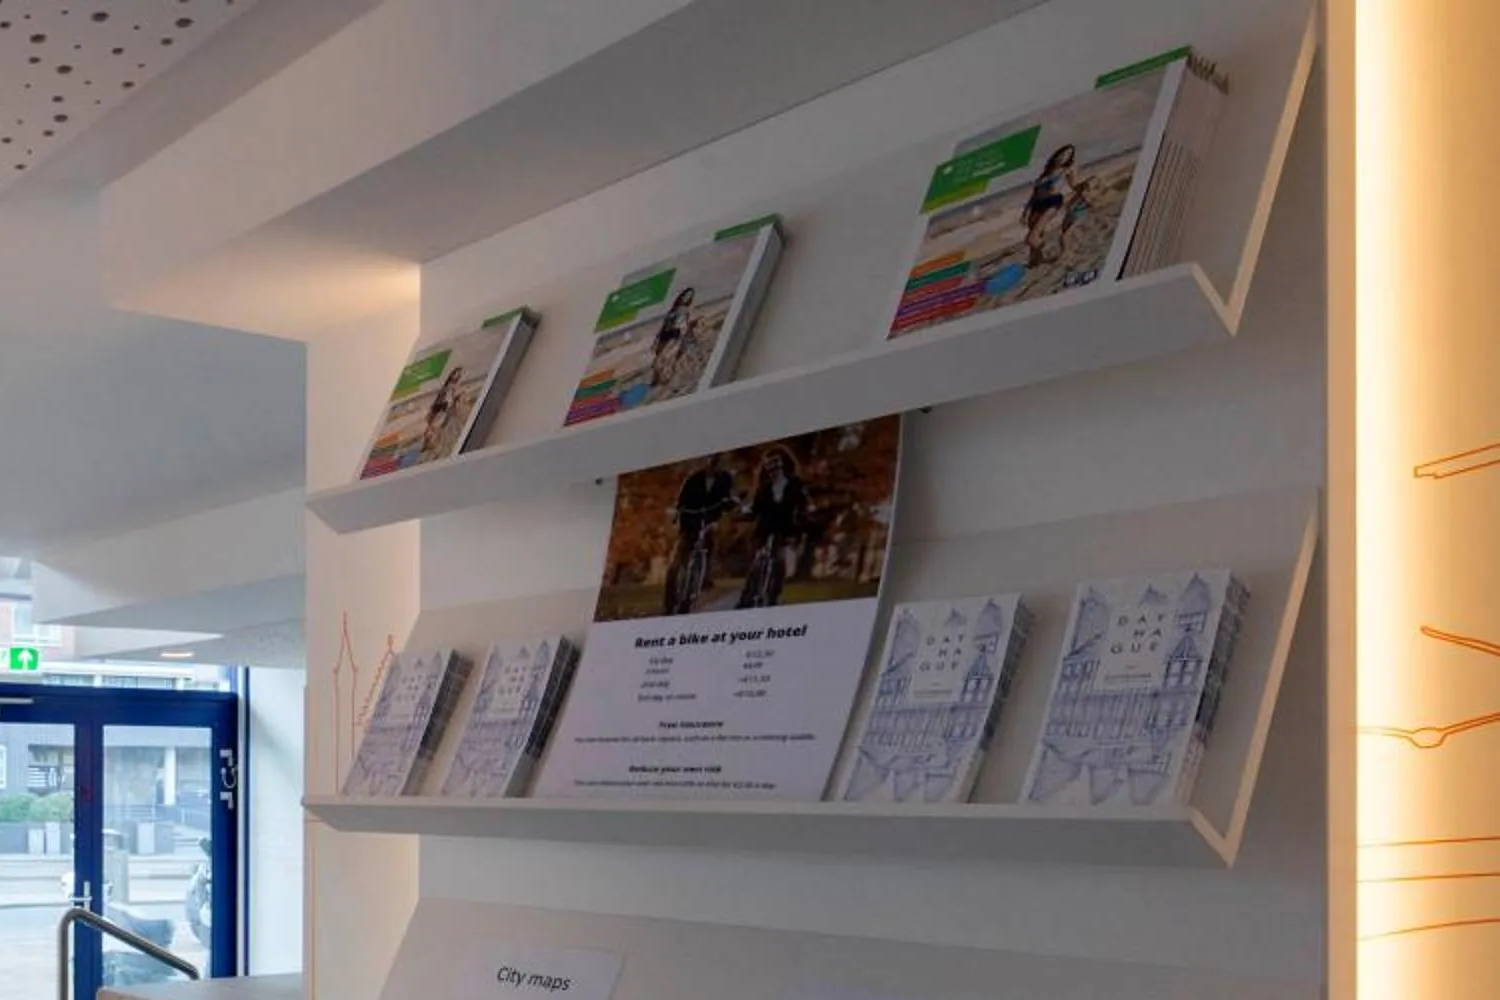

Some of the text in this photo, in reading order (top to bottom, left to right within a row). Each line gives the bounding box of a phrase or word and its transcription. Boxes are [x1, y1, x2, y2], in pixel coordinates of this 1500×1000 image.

[635, 624, 807, 649] Rent a bike at your hotel
[497, 966, 571, 993] City maps
